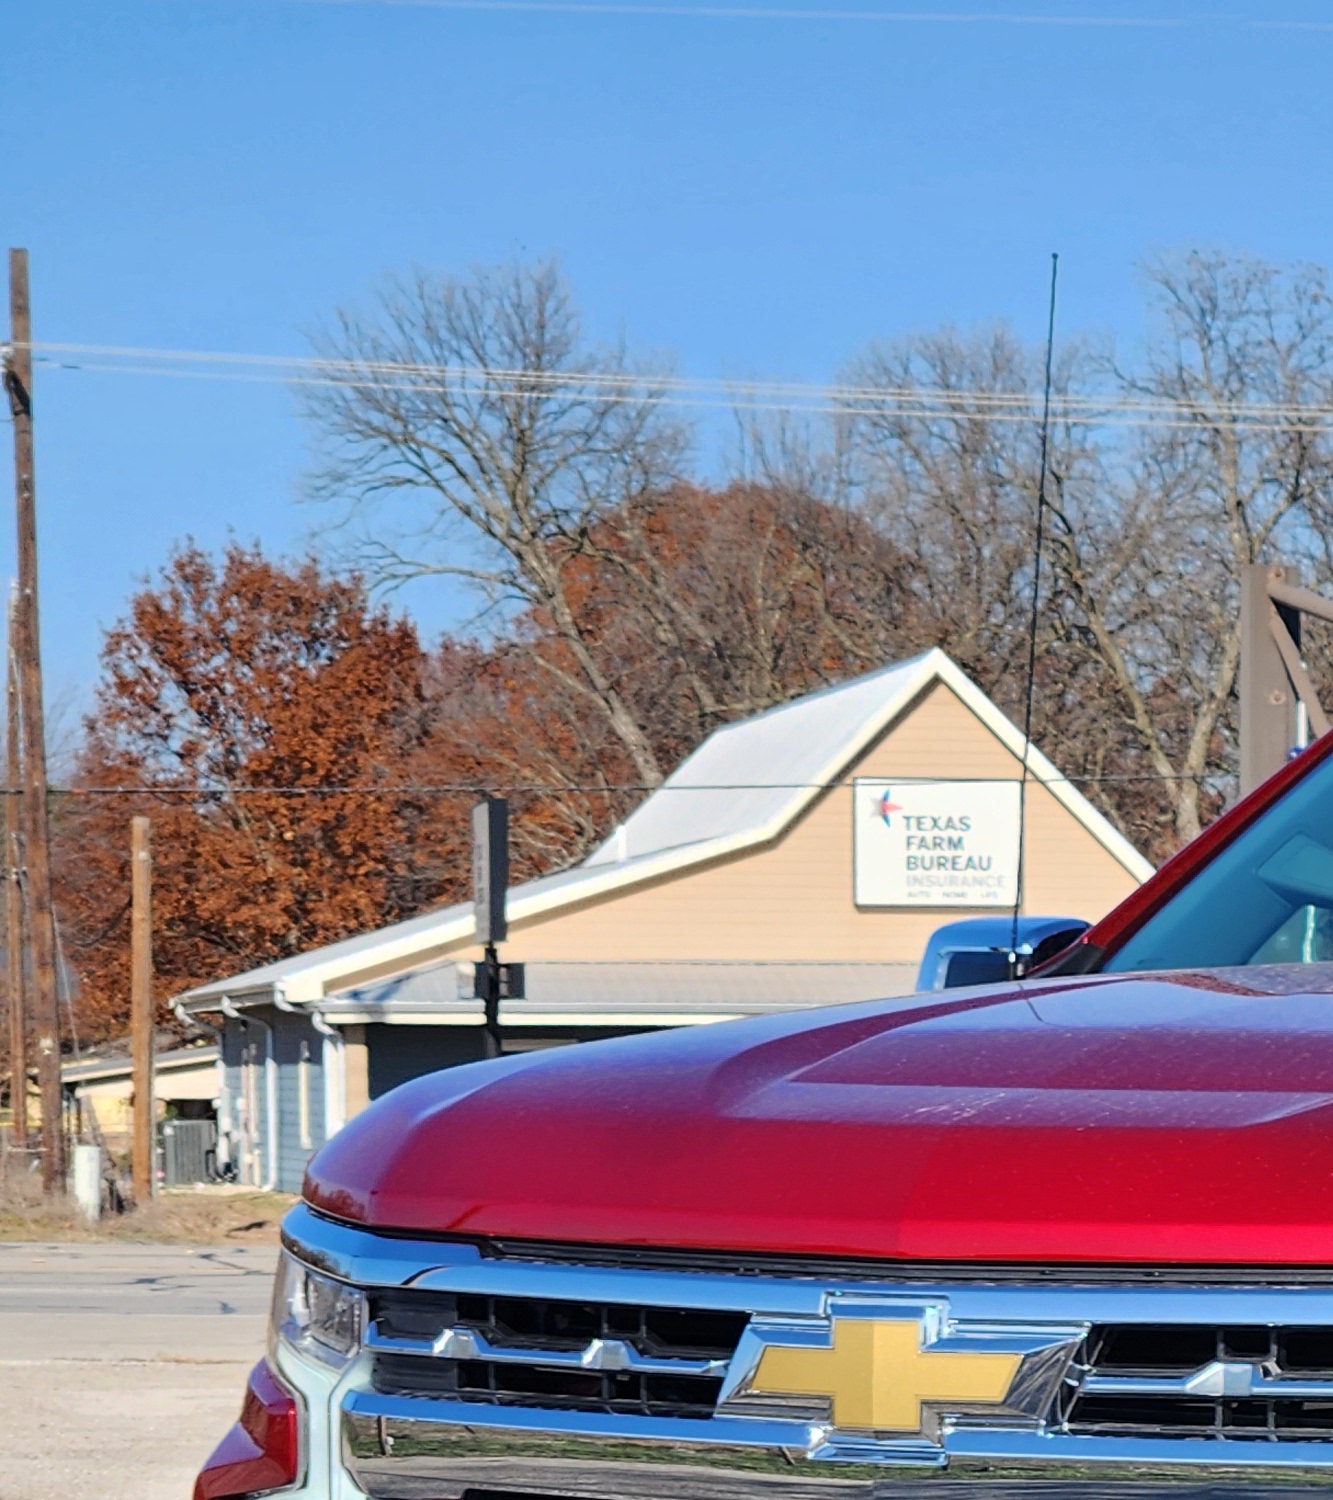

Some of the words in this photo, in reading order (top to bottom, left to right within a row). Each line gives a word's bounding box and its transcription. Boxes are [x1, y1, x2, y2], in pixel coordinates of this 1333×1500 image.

[902, 815, 972, 831] TEXAS
[906, 835, 965, 851] FARM
[906, 855, 993, 872] BUREAU
[906, 874, 1006, 888] INSURANCE
